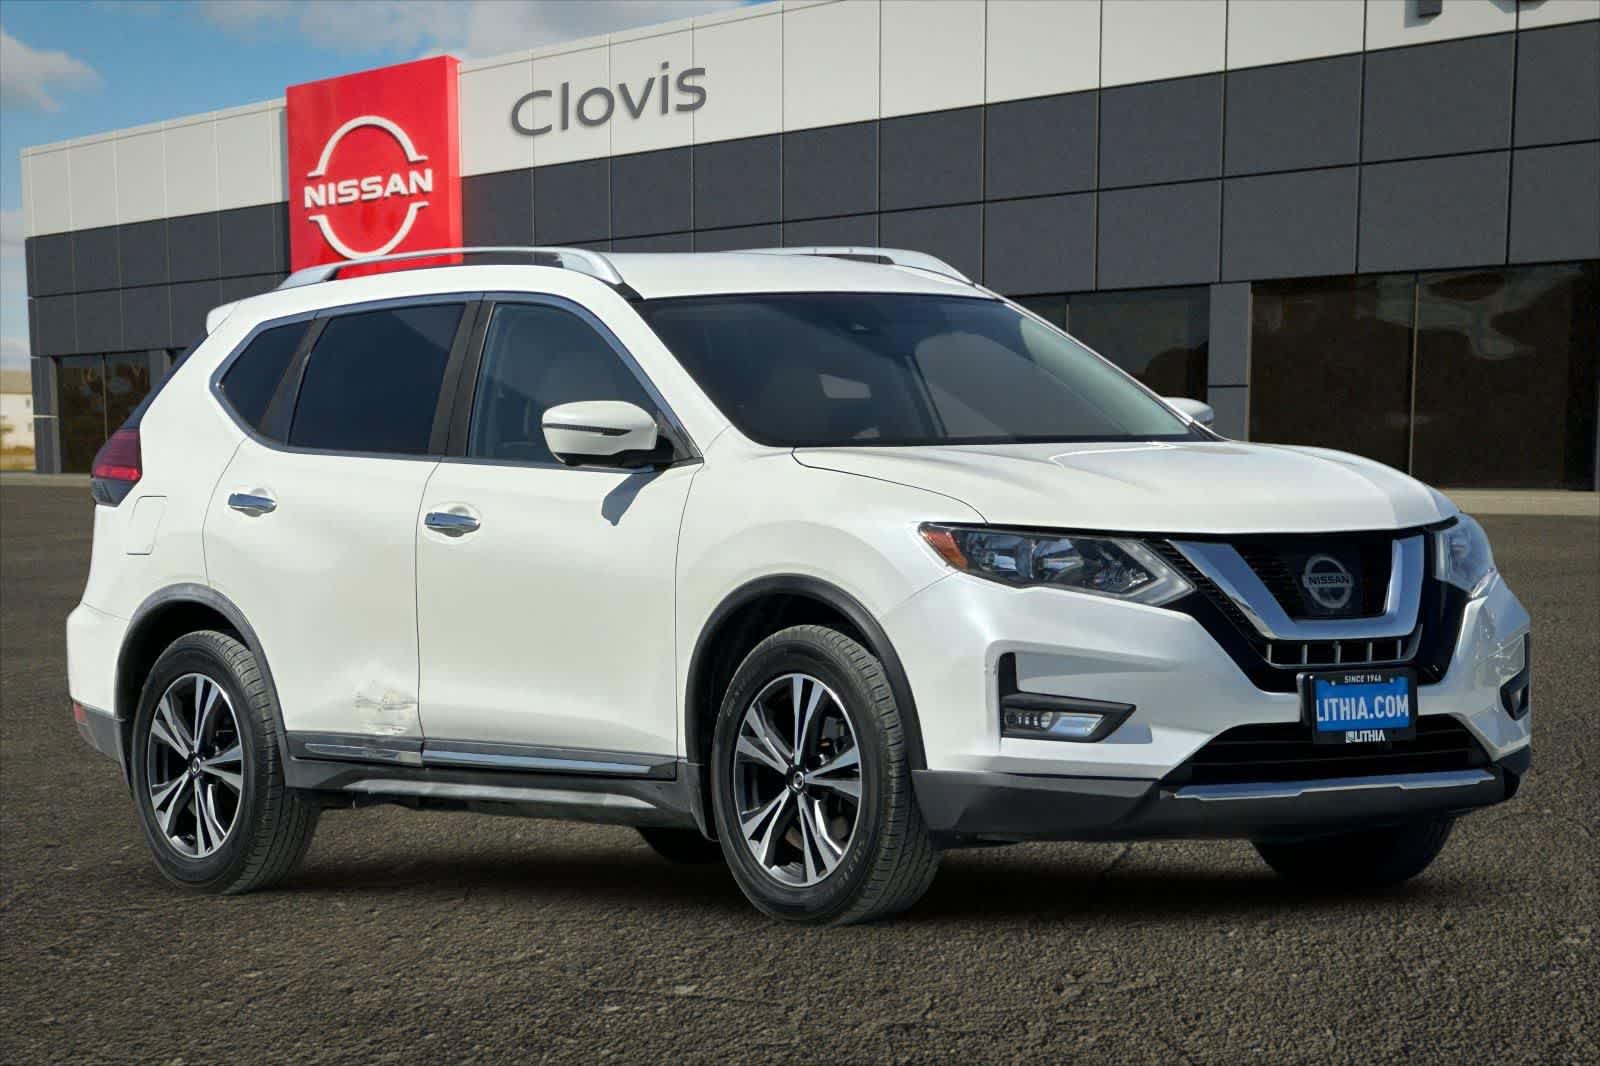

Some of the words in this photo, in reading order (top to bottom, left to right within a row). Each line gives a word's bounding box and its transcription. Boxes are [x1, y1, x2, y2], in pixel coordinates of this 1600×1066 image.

[511, 61, 707, 136] Clovis
[304, 168, 433, 208] NISSAN
[1307, 574, 1351, 586] NISSAN
[1344, 674, 1365, 684] SINCE
[1316, 694, 1409, 722] LITHIA.COM
[1354, 729, 1385, 743] LITHIA
